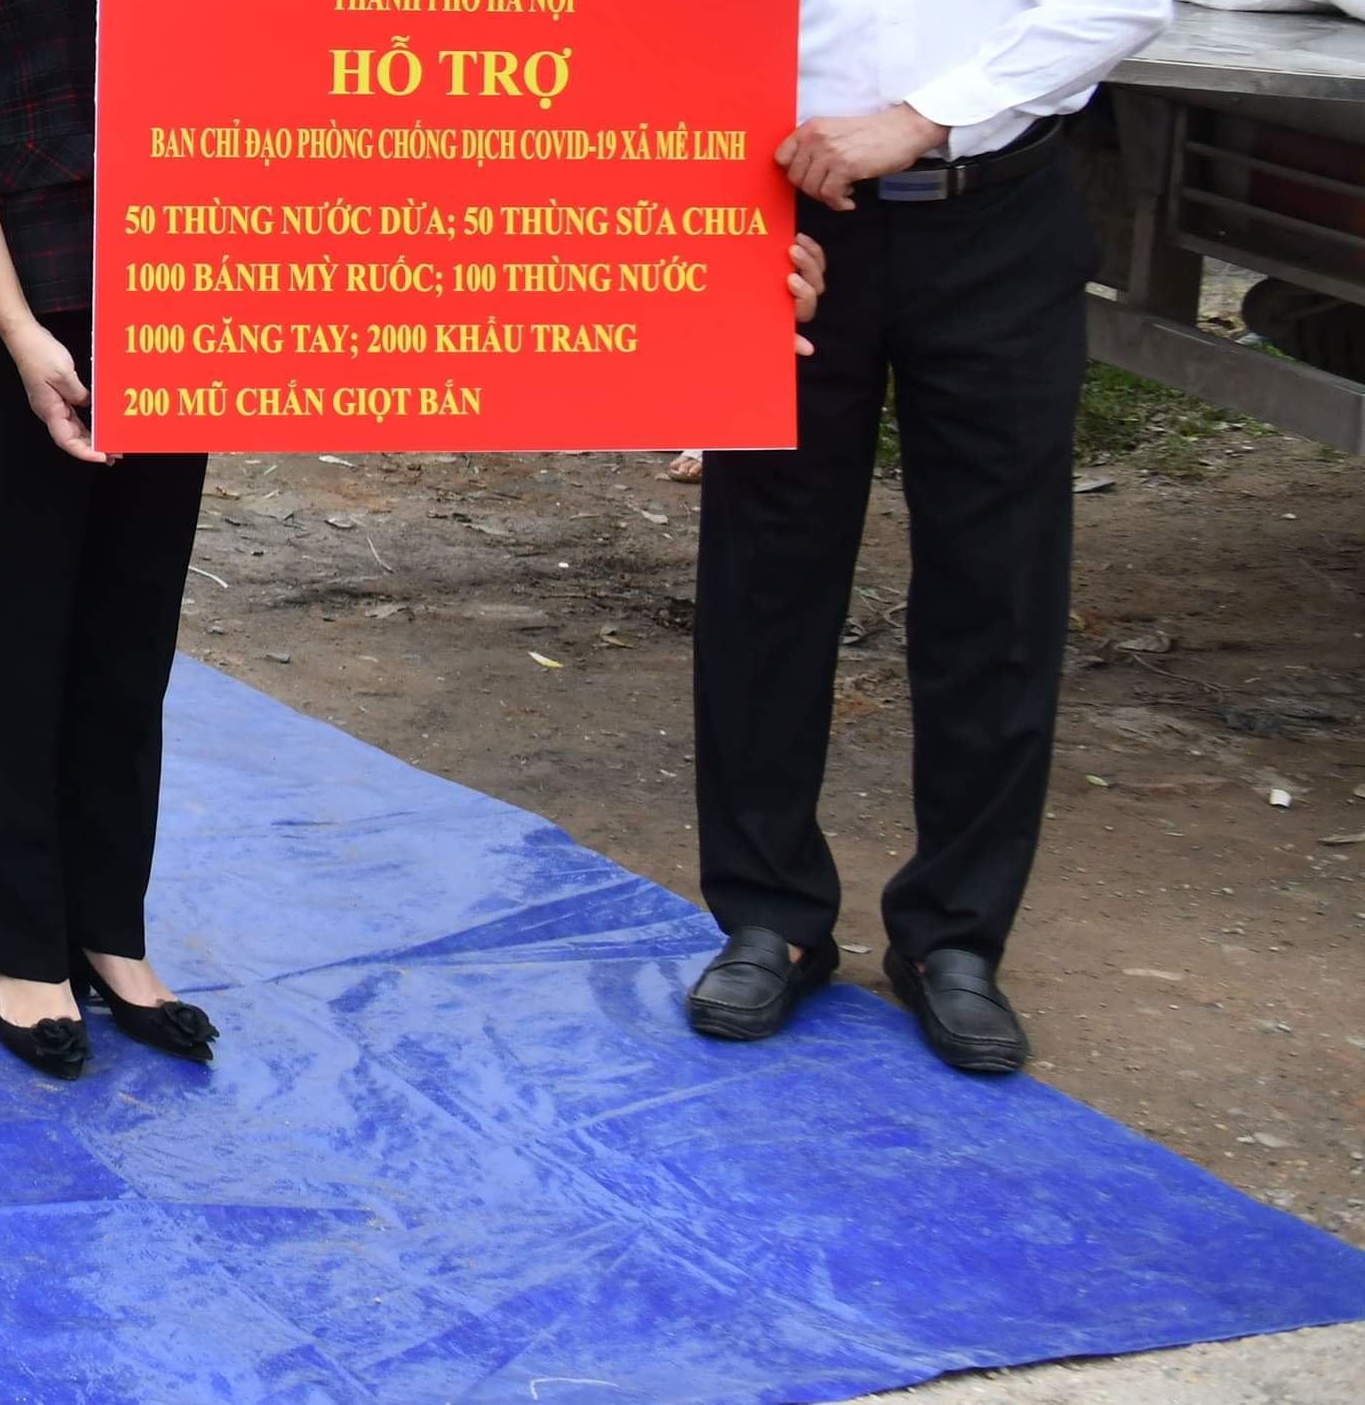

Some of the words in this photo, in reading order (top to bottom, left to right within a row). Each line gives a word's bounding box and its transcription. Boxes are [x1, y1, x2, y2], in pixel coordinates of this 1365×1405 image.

[329, 36, 422, 95] HỖ
[439, 48, 572, 109] TRỢ
[151, 128, 195, 157] BAN
[201, 119, 240, 158] CHỈ
[245, 128, 292, 166] ĐẠO
[297, 119, 373, 159] PHÒNG
[378, 120, 456, 159] CHỐNG
[462, 130, 515, 167] DỊCH
[521, 130, 616, 159] COVID-19
[621, 123, 651, 159] XÃ
[656, 122, 688, 159] MÊ
[693, 131, 745, 160] LINH
[125, 206, 155, 234] 50
[163, 198, 273, 234] THÙNG
[282, 198, 371, 234] NƯỚC
[380, 198, 455, 240] DỪA;
[464, 207, 493, 235] 50
[501, 199, 608, 235] THÙNG
[617, 200, 677, 235] SỮA
[683, 207, 767, 235] CHUA
[127, 263, 185, 291] 1000
[193, 255, 280, 291] BÁNH
[289, 255, 338, 291] MỲ
[346, 255, 442, 297] RUỐC;
[453, 264, 496, 291] 100
[503, 256, 611, 292] THÙNG
[619, 256, 706, 291] NƯỚC
[126, 324, 185, 353] 1000
[193, 317, 284, 353] GĂNG
[291, 325, 358, 358] TAY;
[367, 324, 427, 353] 2000
[435, 316, 523, 353] KHẨU
[531, 324, 637, 352] TRANG
[124, 388, 170, 416] 200
[178, 381, 227, 416] MŨ
[236, 380, 324, 416] CHẮN
[333, 388, 411, 423] GIỌT
[419, 379, 481, 415] BẮN
